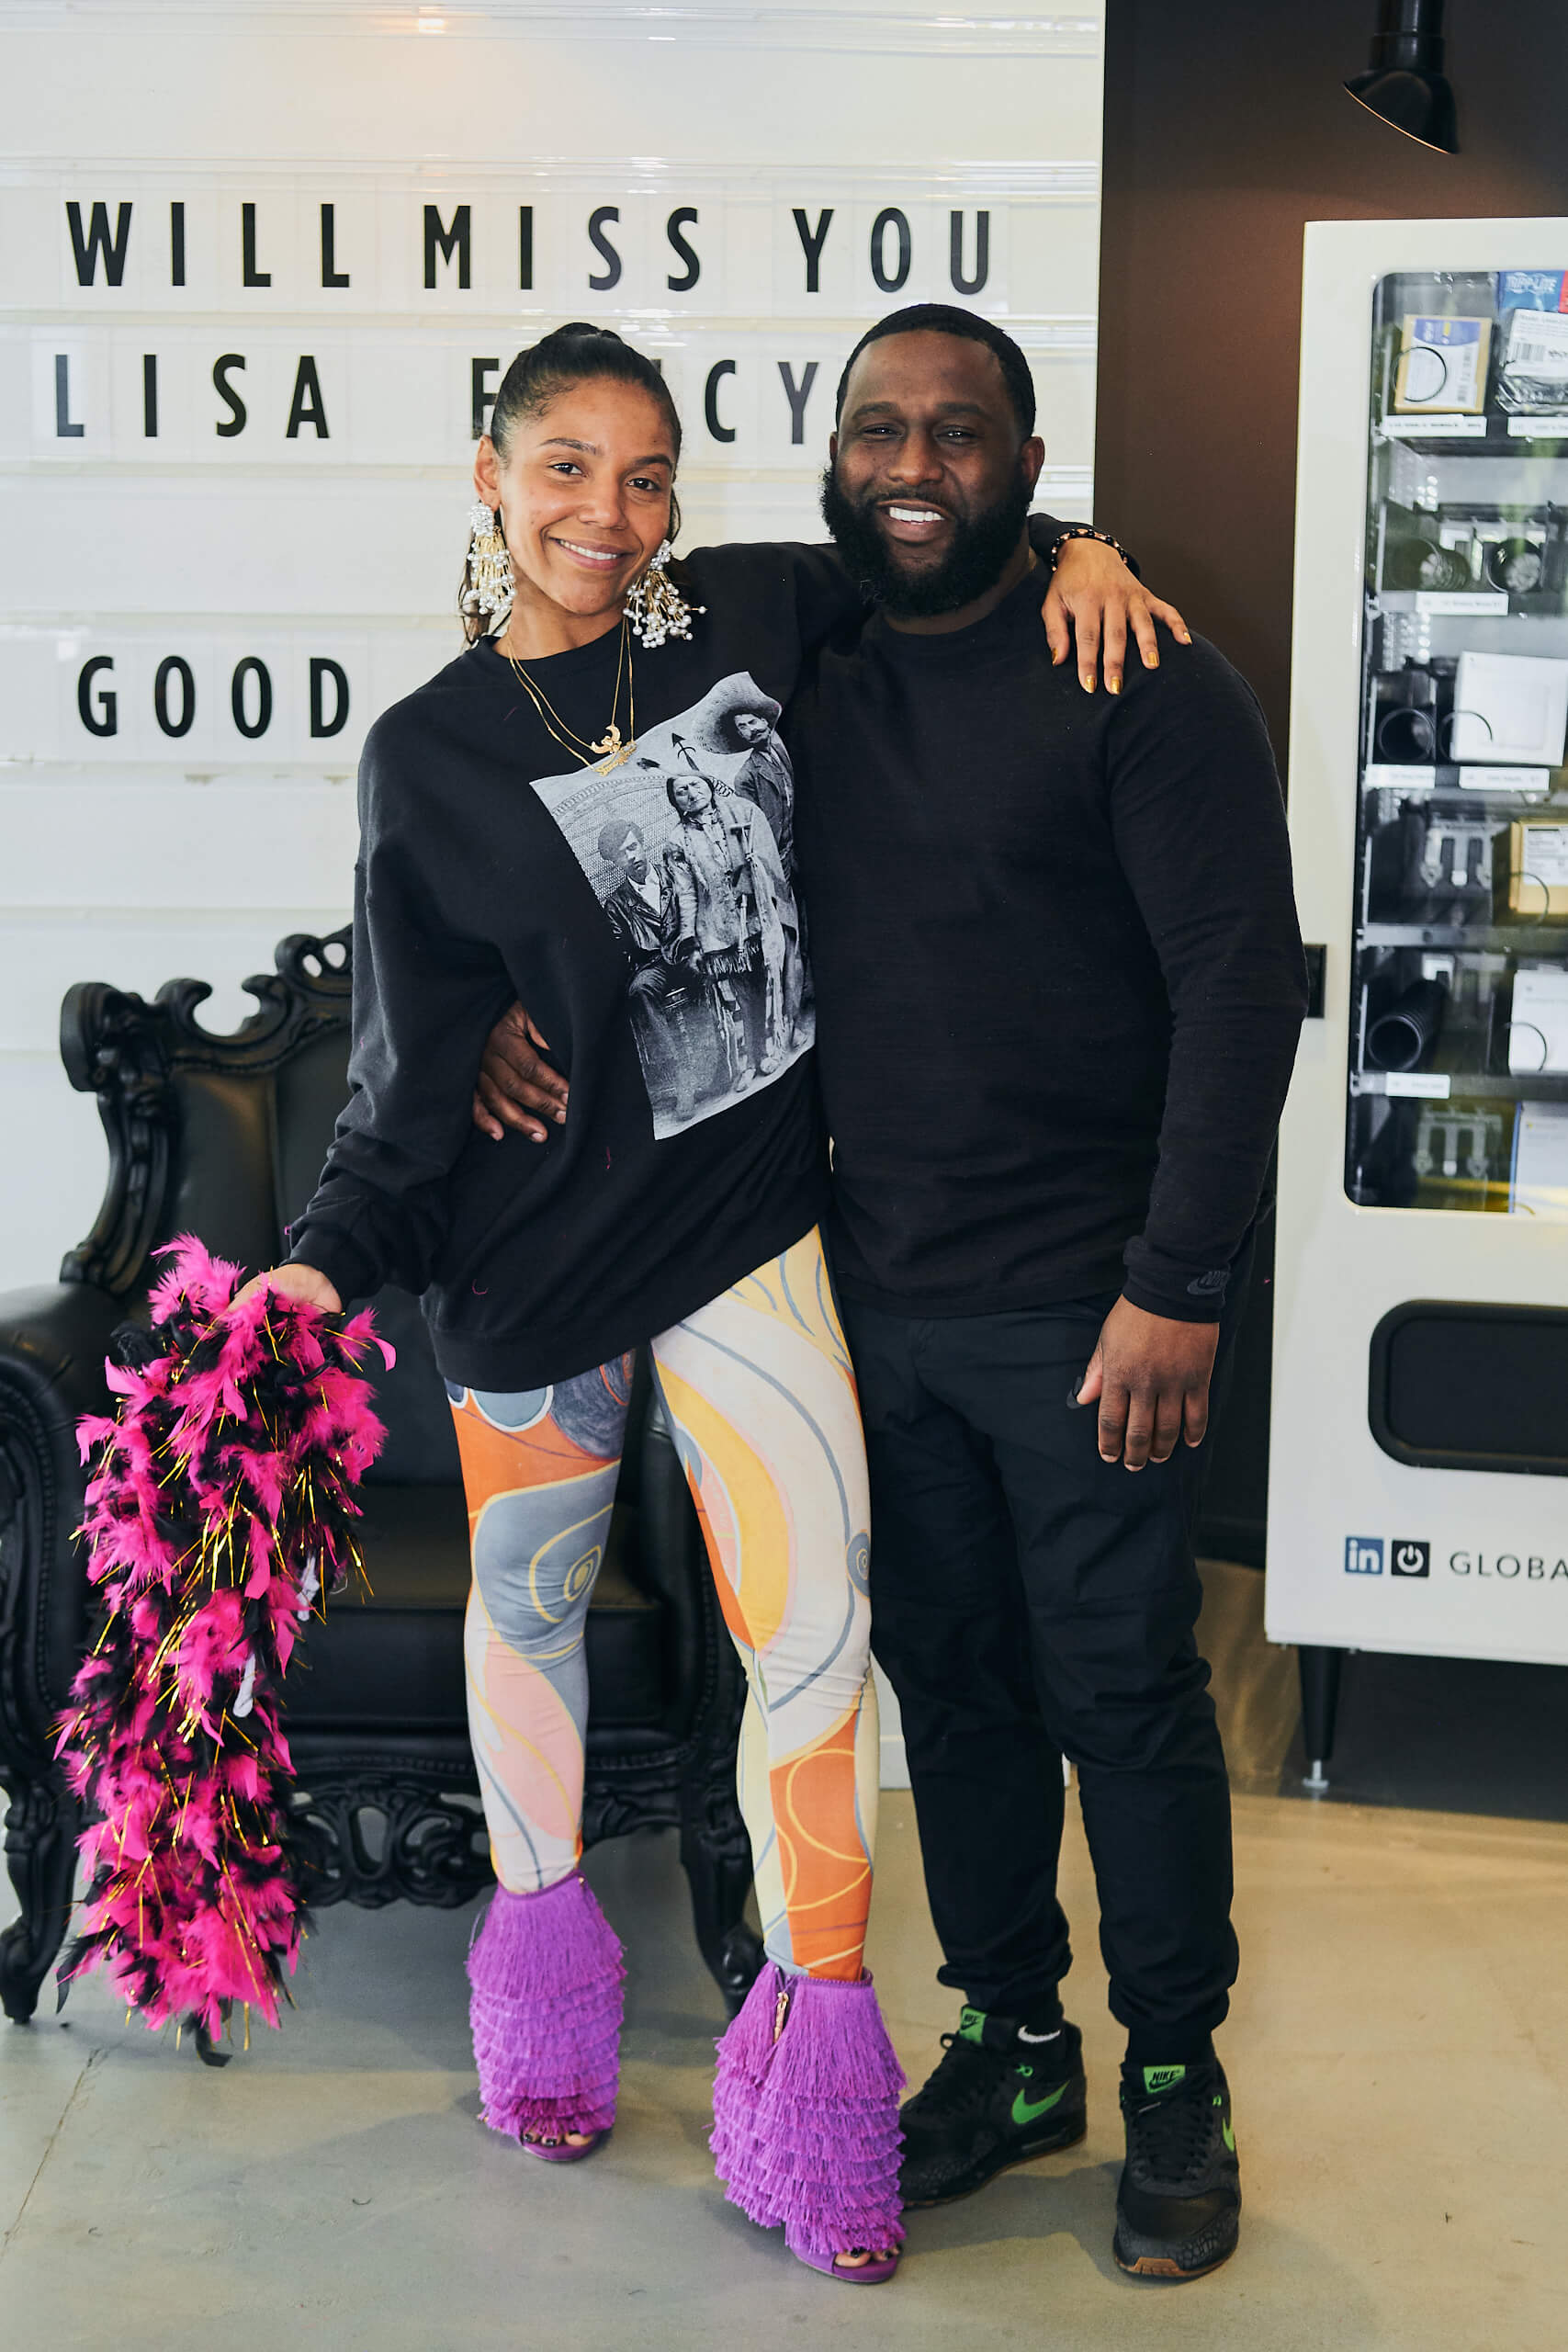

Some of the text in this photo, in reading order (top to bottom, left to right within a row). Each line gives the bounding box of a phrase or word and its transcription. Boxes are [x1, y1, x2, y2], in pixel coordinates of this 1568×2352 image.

[65, 201, 990, 295] WILL MISS YOU
[55, 353, 819, 445] LISA FCY
[77, 655, 350, 739] GOOD
[1152, 2069, 1176, 2081] NIKE
